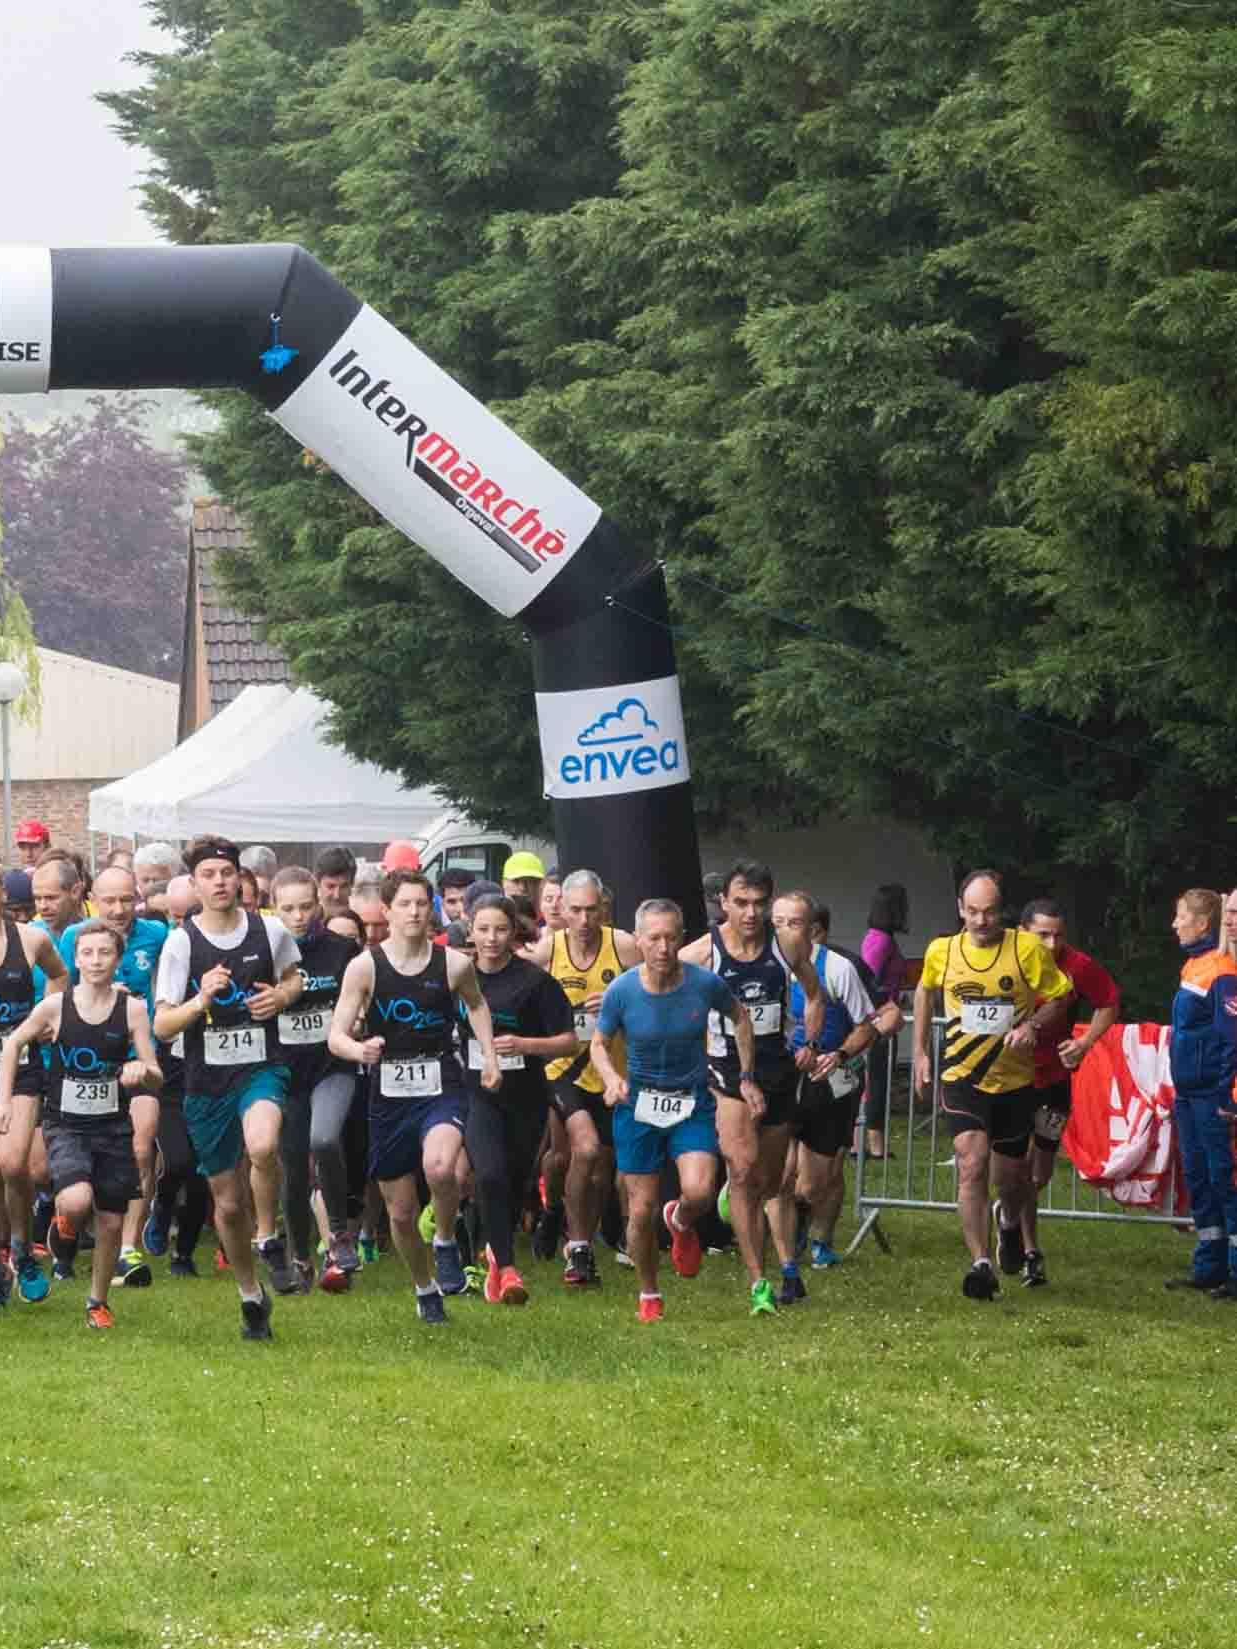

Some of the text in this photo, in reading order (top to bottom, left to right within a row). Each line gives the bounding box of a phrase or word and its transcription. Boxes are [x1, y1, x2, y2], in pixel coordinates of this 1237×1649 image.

[455, 496, 497, 534] Orgeval
[560, 738, 680, 784] envea
[977, 1006, 998, 1021] 42
[291, 1014, 323, 1032] 209
[219, 1031, 253, 1049] 214
[394, 1064, 426, 1081] 211
[75, 1083, 110, 1100] 239
[652, 1097, 682, 1114] 104
